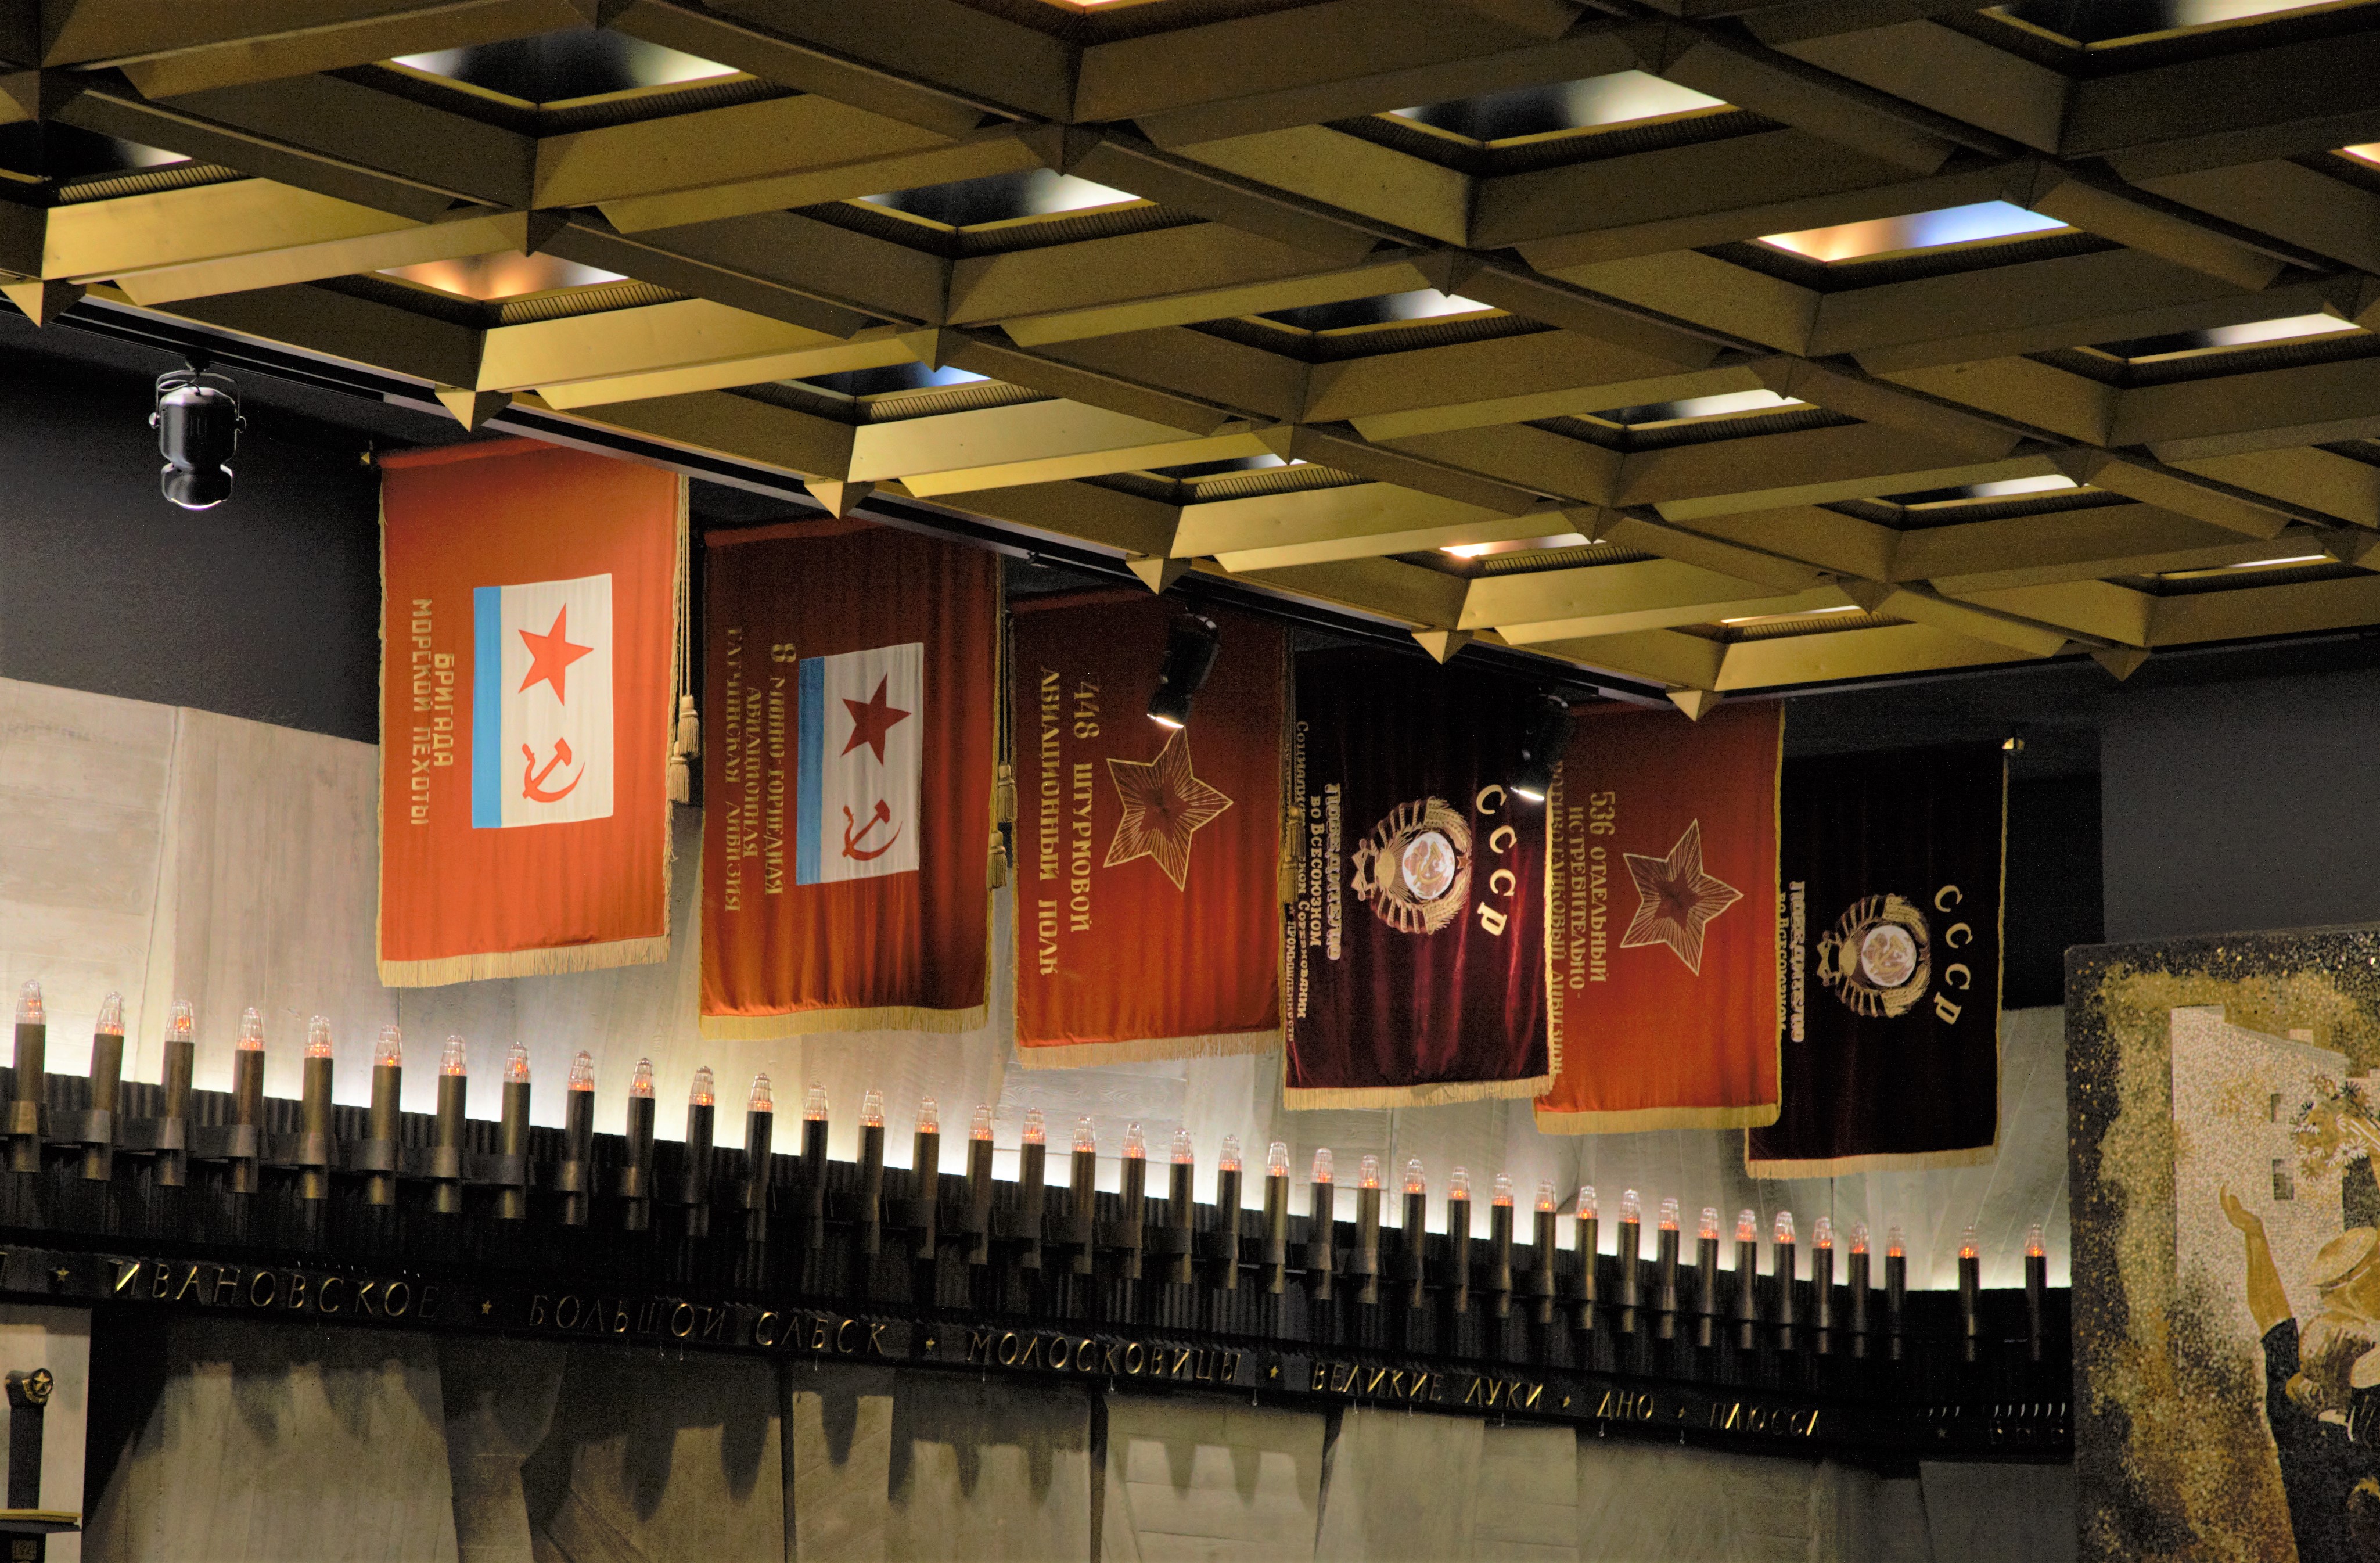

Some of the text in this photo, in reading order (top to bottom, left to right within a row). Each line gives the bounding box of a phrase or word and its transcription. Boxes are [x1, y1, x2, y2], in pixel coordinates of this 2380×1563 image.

[411, 599, 433, 825] МОРСКОЙ ПЕХОТЫ
[432, 653, 454, 767] БРИГАДА
[724, 627, 742, 912] ГАТЧИНСКАЯ ДИВИЗИЯ
[743, 687, 762, 858] АВИАЦИОННАЯ
[763, 643, 796, 895] 8 МИННО-ТОРПЕДНАЯ
[1038, 667, 1061, 977] АВИАЦИОННЫЙ ПОЛК
[1070, 681, 1100, 933] 448 ШТУРМОВОЙ
[1325, 783, 1341, 960] ПОБЕДИТЕЛЮ
[1476, 784, 1518, 936] СССР
[1589, 791, 1616, 982] 536 ОТДЕЛЬНЫЙ
[1789, 881, 1806, 1043] ПОБЕДИТЕЛЮ
[1933, 885, 1973, 1025] СССР
[115, 1263, 440, 1319] ИВАНОВСКОЕ
[529, 1295, 725, 1340] БОЛЬШОЙ
[756, 1311, 887, 1356] САБСК
[968, 1332, 1241, 1382] МОЛОСКОВИЦЫ
[1311, 1362, 1444, 1402] ВЕЛИКИЕ
[1465, 1377, 1543, 1409] ЛУКИ
[1597, 1391, 1654, 1421] ДНО
